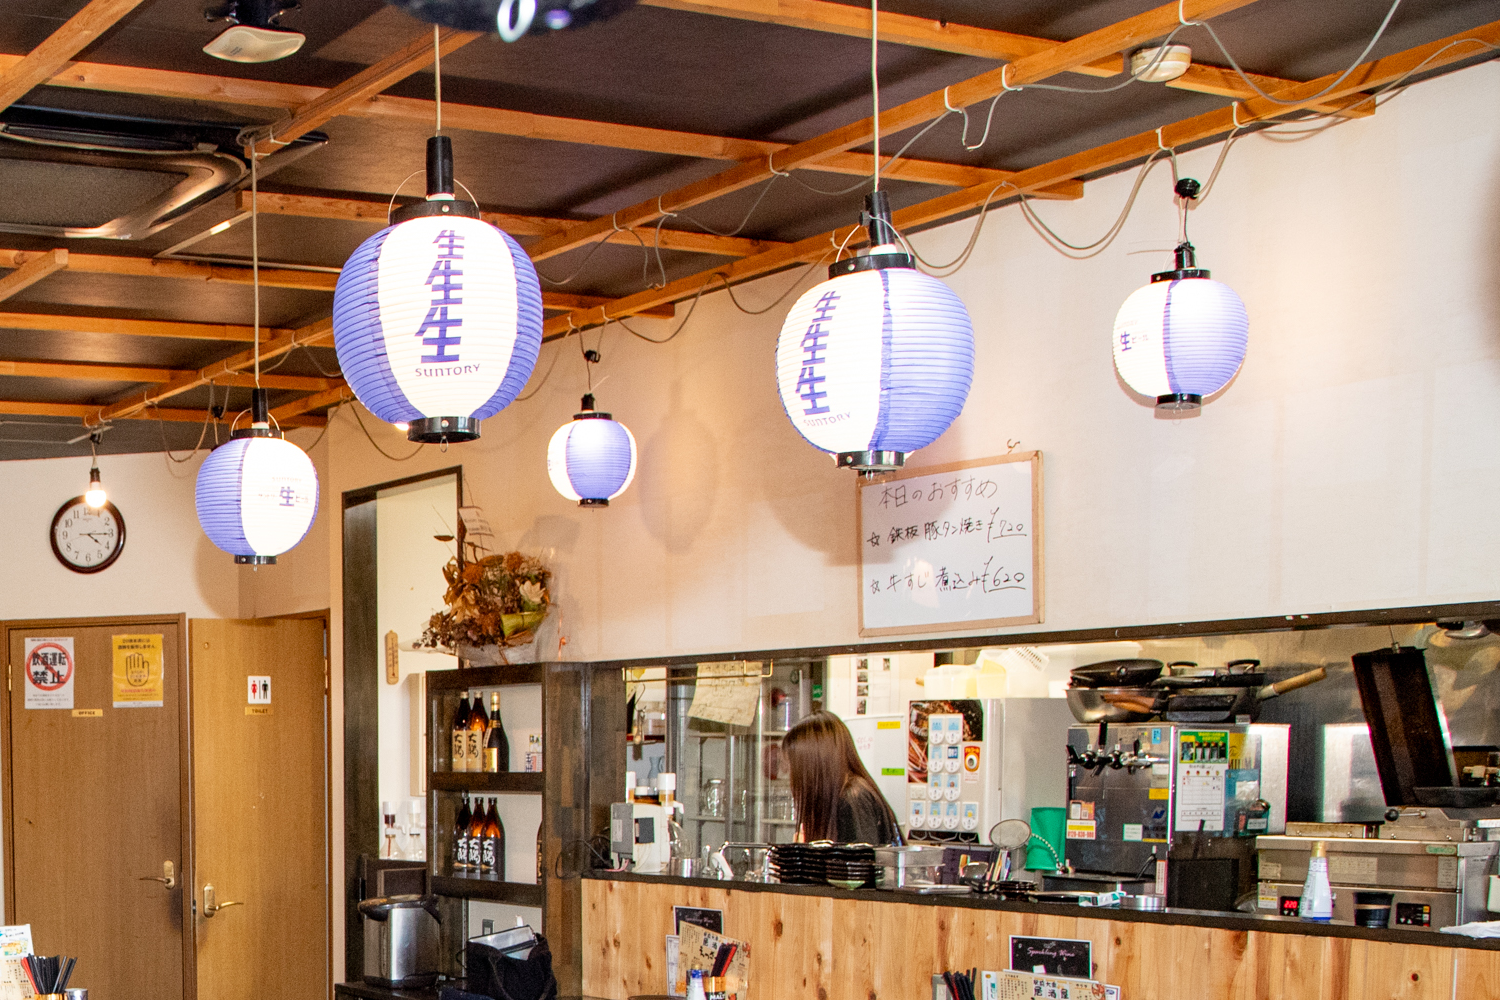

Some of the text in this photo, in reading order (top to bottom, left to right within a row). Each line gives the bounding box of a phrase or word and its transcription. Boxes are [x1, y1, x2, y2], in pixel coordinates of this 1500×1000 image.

[415, 364, 481, 377] SUNTORY
[804, 411, 851, 427] SUNTORY
[878, 475, 998, 509] 本日のおすすめ
[65, 519, 73, 528] 10
[104, 517, 110, 526] 2
[62, 531, 68, 539] 9
[66, 543, 72, 551] 8
[105, 541, 110, 550] 4
[74, 551, 79, 559] 7
[85, 554, 91, 562] 6
[97, 550, 102, 558] 5
[32, 652, 67, 667] 飲酒運転
[32, 670, 66, 685] 禁止
[1027, 946, 1075, 958] Sparkling Wine
